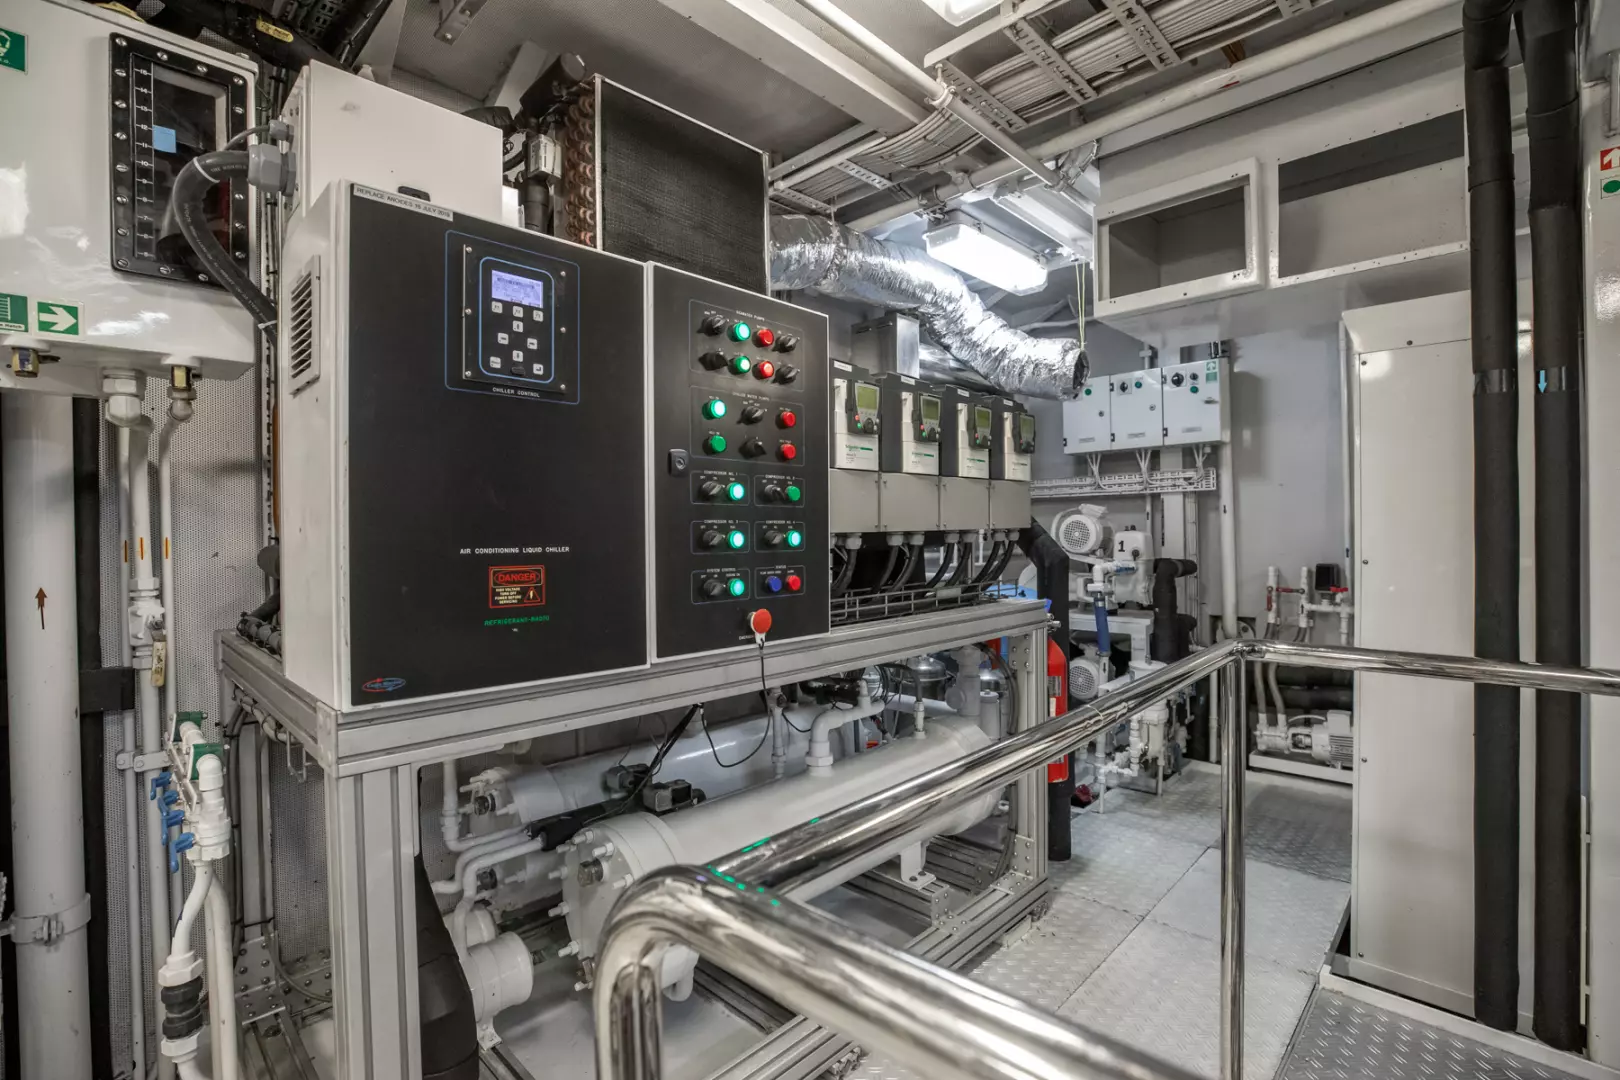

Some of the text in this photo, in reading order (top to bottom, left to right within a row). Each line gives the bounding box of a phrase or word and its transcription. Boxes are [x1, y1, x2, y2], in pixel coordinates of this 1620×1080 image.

[356, 187, 384, 200] REPLACE
[386, 196, 413, 208] ANODES
[423, 206, 436, 214] JULY
[492, 386, 540, 398] CHILLER CONTROL
[1118, 540, 1125, 552] 1
[498, 572, 537, 582] DANGER
